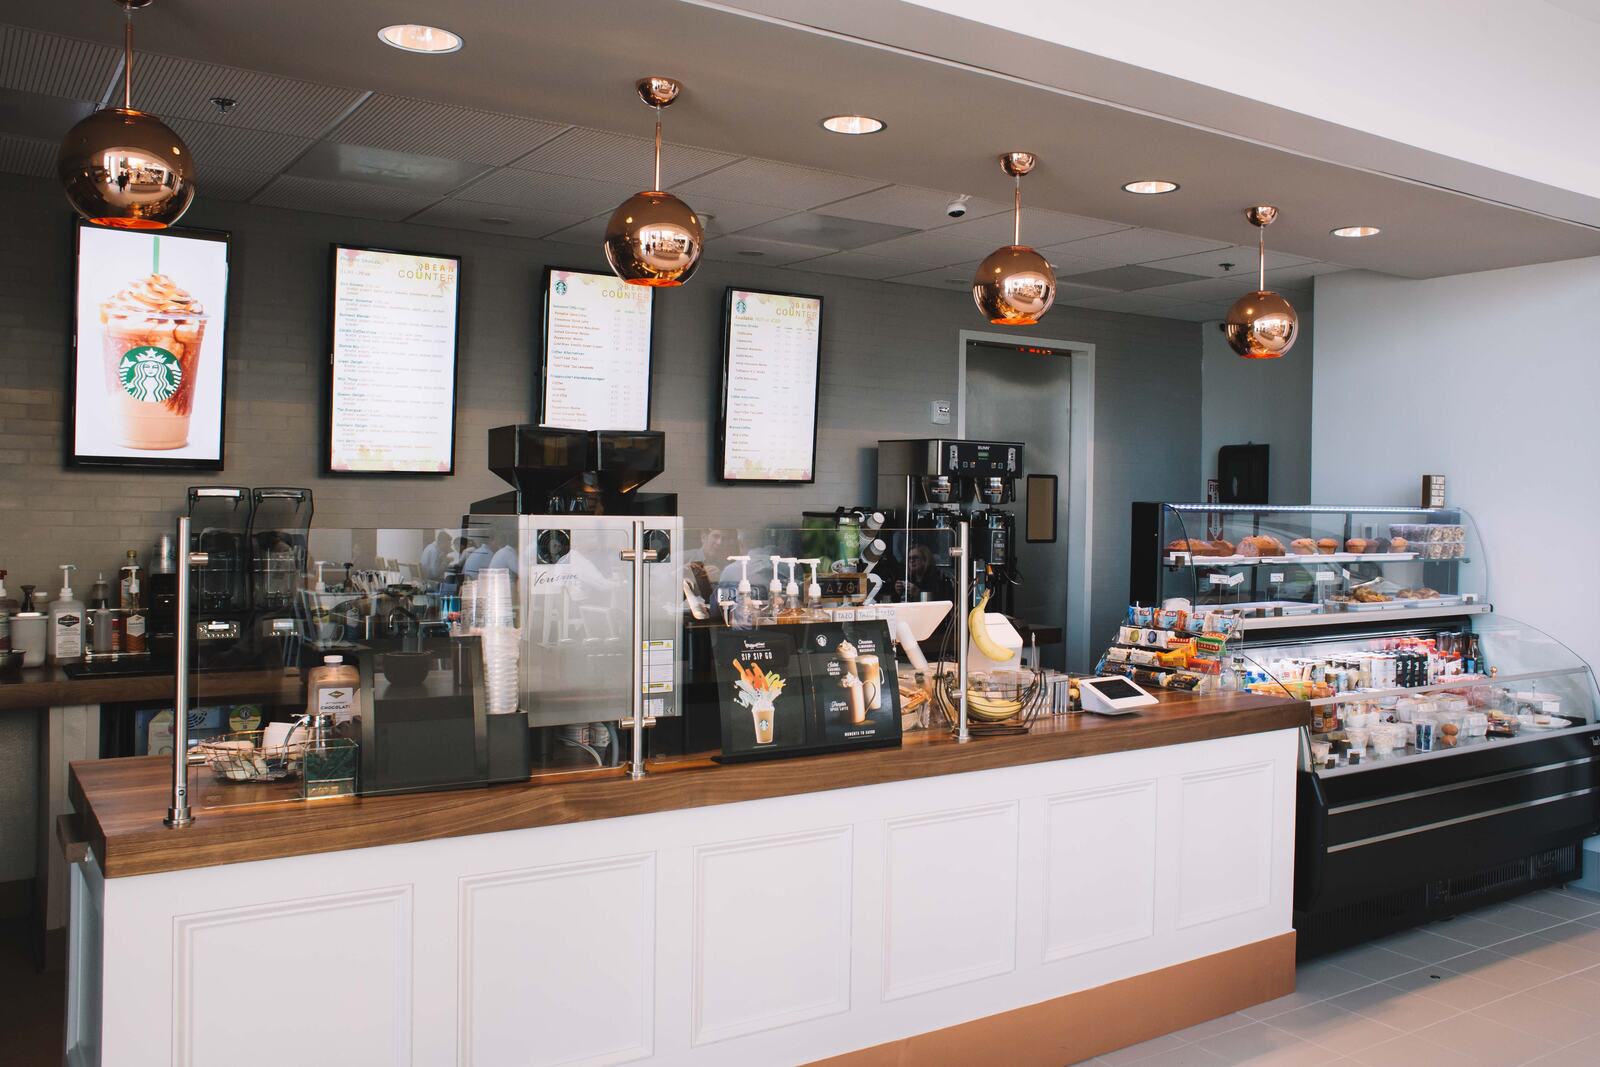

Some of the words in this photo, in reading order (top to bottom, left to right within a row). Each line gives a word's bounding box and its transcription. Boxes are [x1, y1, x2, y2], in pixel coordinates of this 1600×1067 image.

[398, 270, 455, 283] COUNTER
[776, 308, 818, 319] COUNTER
[837, 611, 853, 620] TAZO
[741, 652, 751, 661] SIP
[753, 652, 763, 661] SIP
[765, 651, 773, 660] GO
